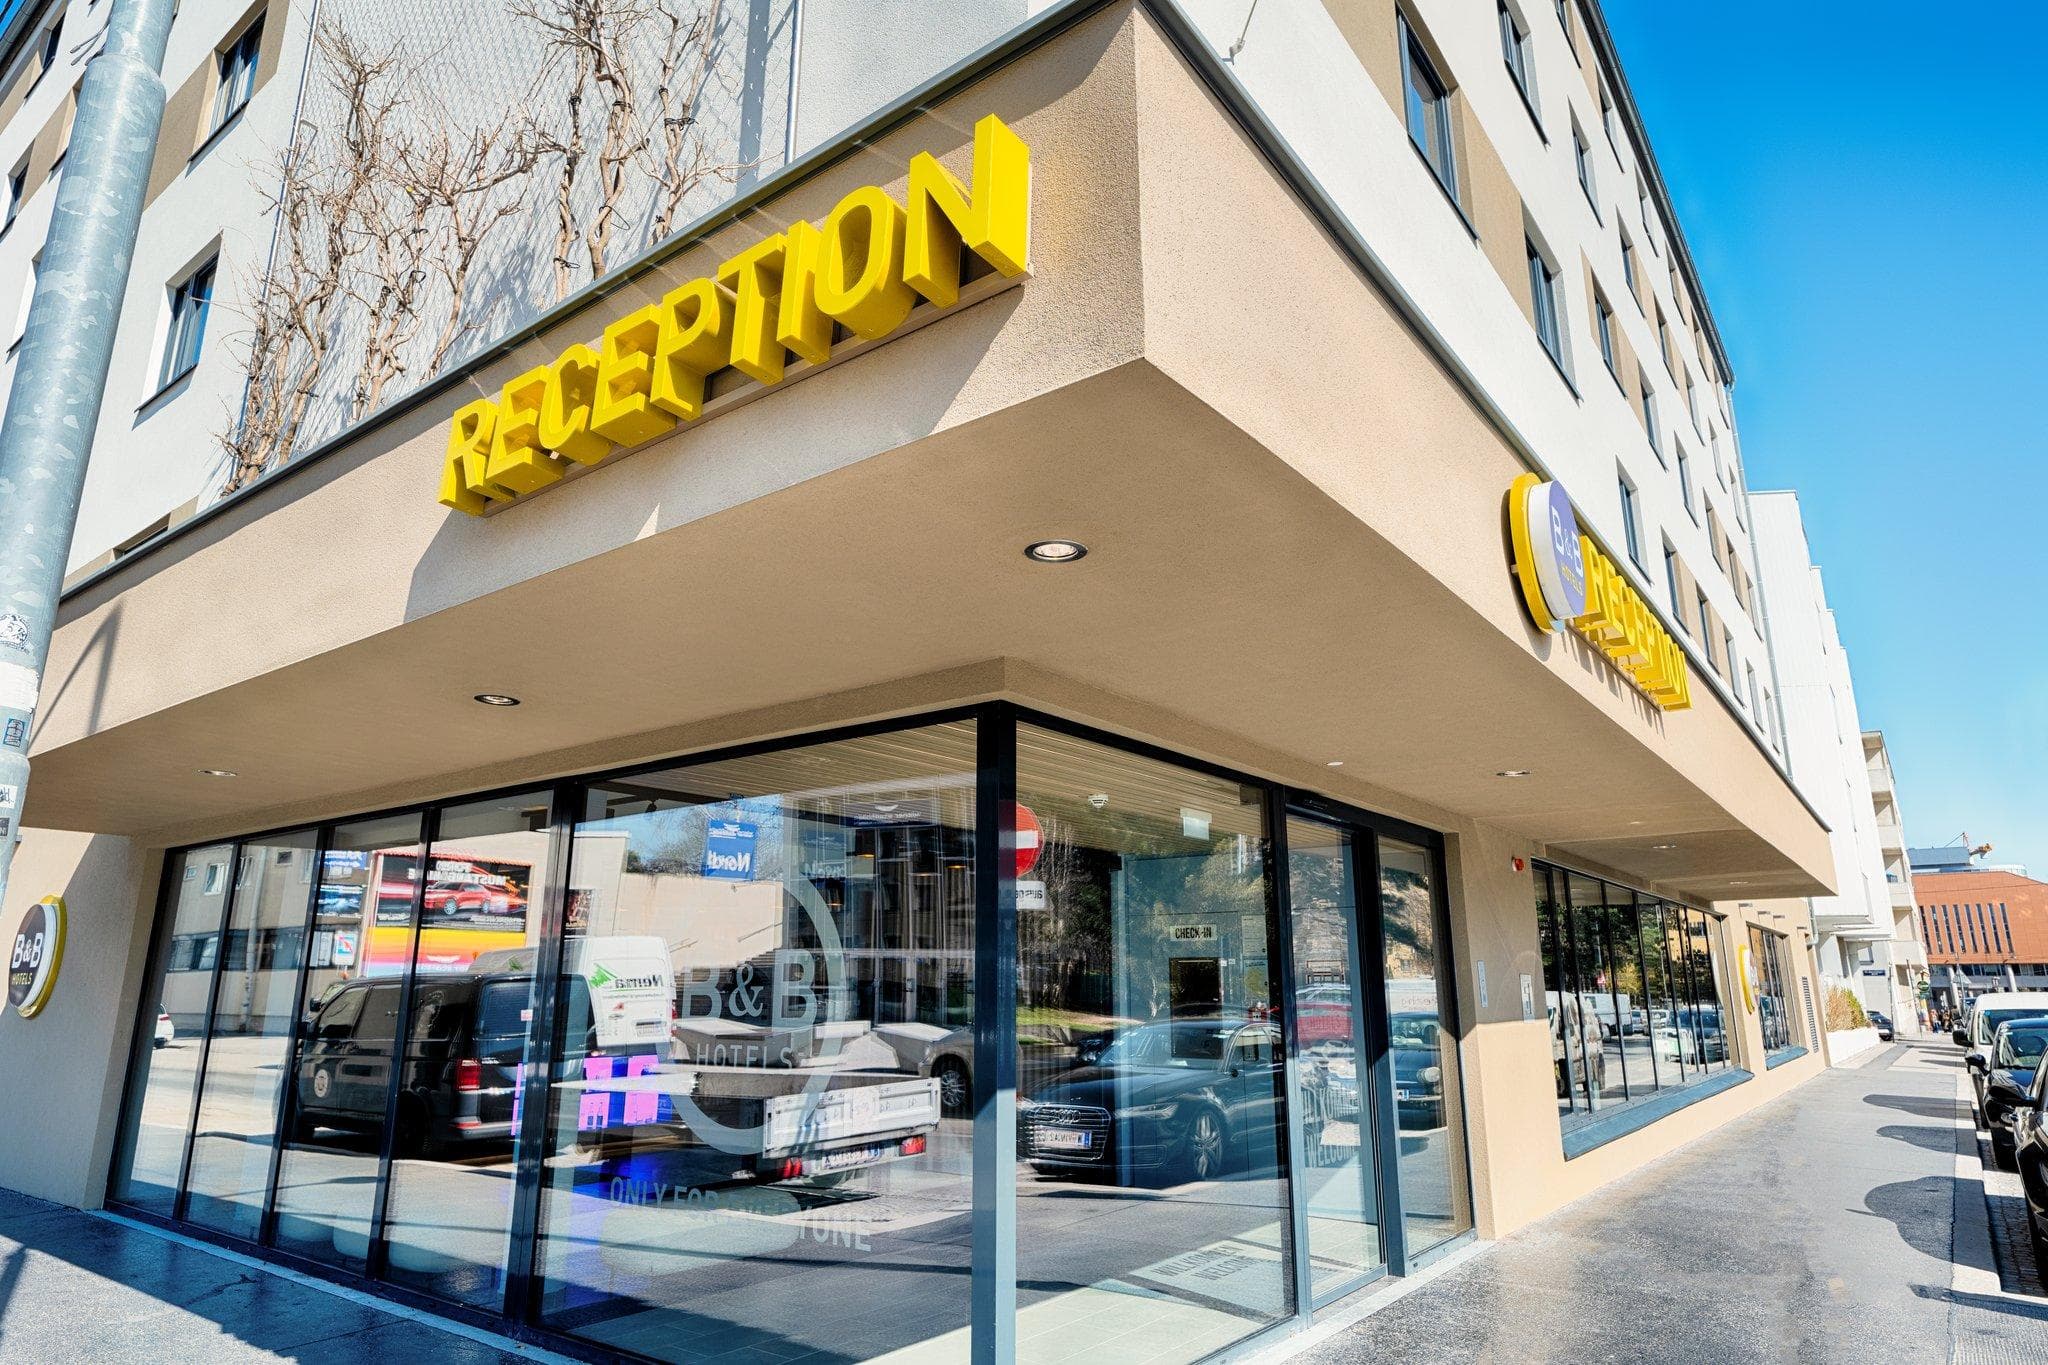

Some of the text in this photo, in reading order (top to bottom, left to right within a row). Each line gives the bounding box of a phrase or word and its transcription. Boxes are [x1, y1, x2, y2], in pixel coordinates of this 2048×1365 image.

[438, 112, 1031, 517] RECEPTION
[1551, 505, 1584, 578] B&B
[1561, 565, 1583, 597] HOTELS
[1574, 535, 1692, 711] RECEPTION
[11, 932, 44, 969] B&B
[12, 972, 33, 985] HOTELS
[681, 949, 818, 1032] B&B
[696, 1043, 794, 1070] HOTELS
[610, 1176, 668, 1208] ONLY
